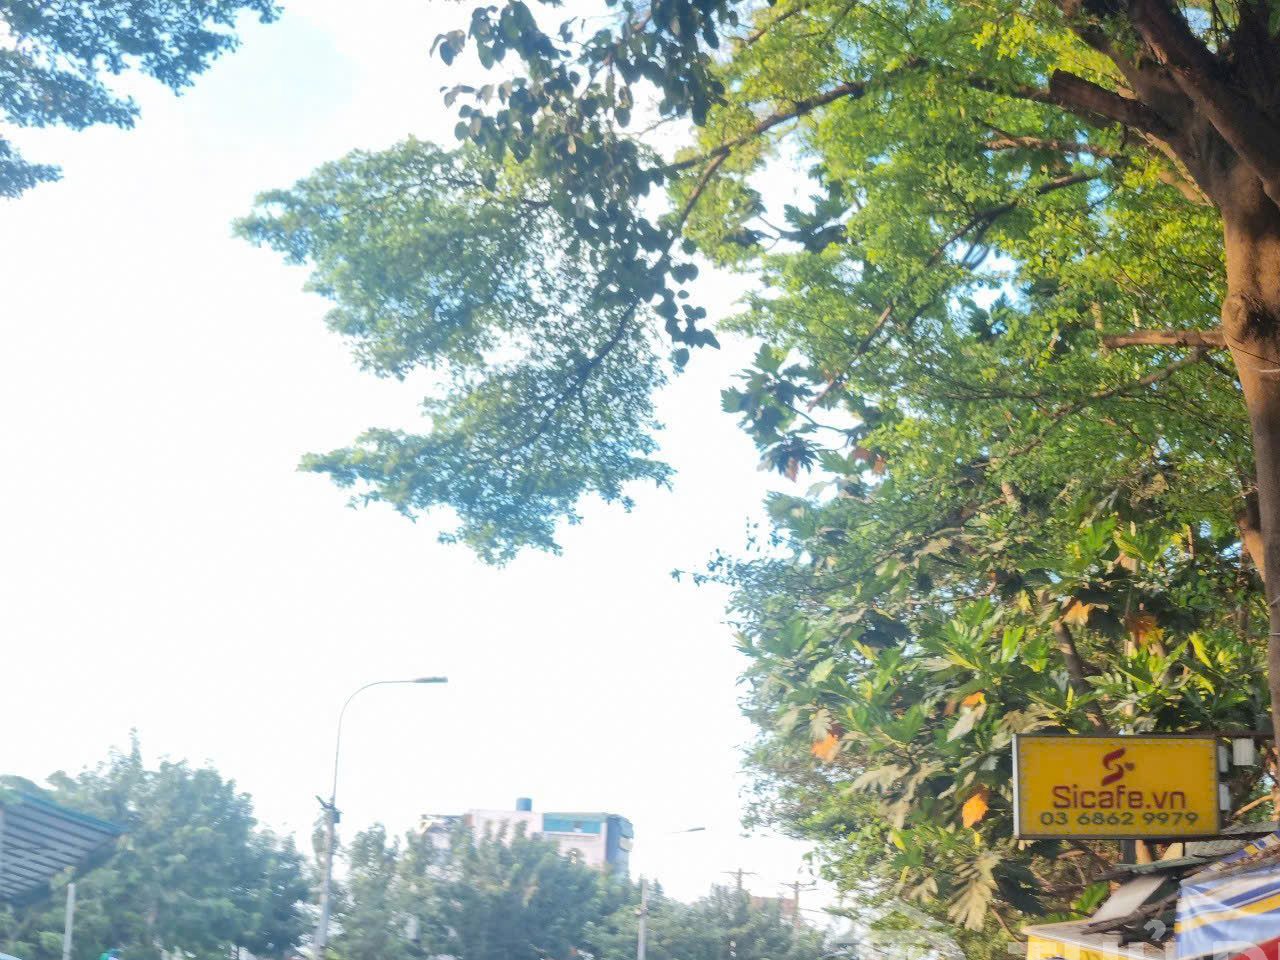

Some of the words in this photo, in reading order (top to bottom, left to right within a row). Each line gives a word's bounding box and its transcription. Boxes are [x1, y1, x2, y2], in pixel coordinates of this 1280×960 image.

[1052, 784, 1187, 810] Sicafe.vn
[1040, 812, 1069, 826] 03
[1076, 812, 1135, 826] 6862
[1142, 812, 1200, 826] 9979
